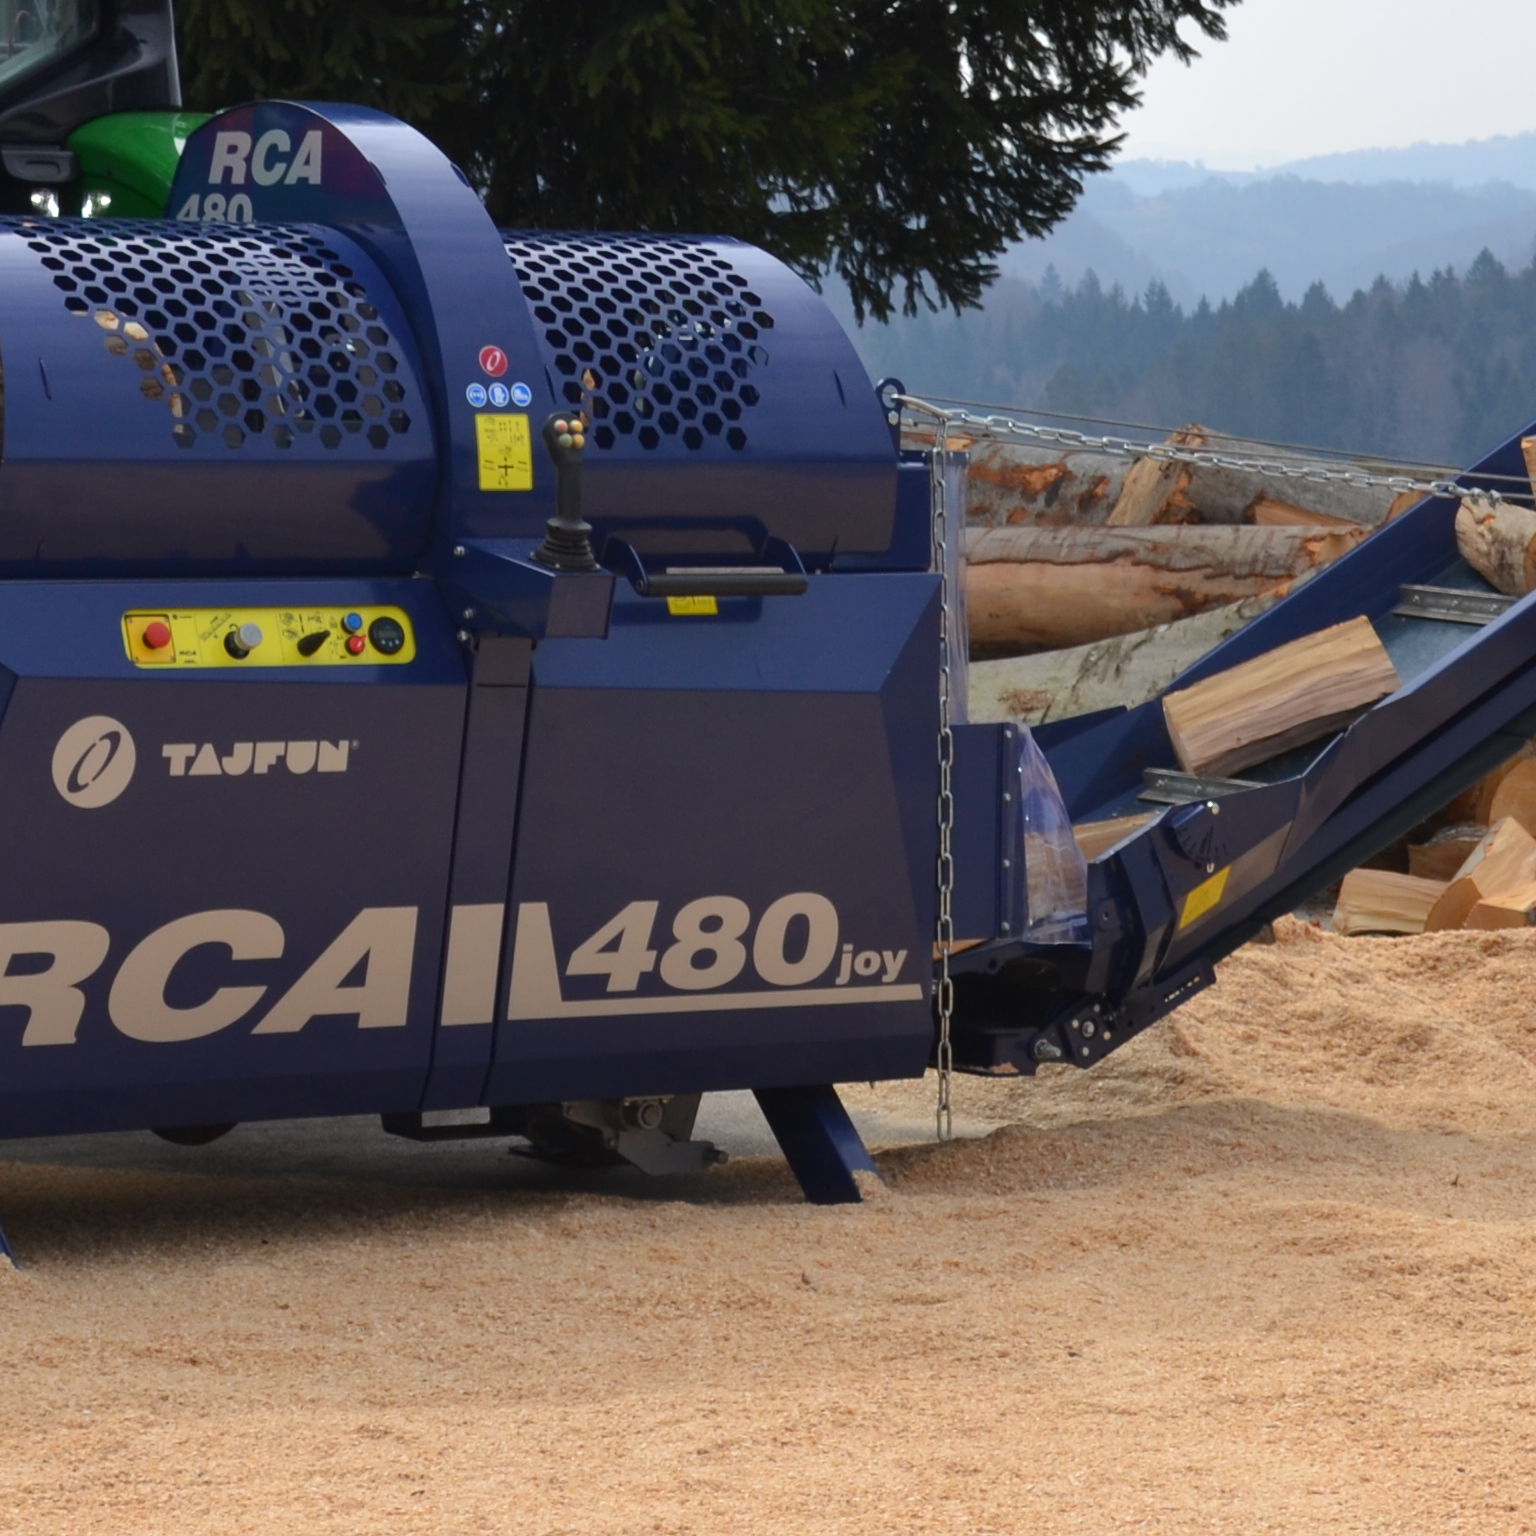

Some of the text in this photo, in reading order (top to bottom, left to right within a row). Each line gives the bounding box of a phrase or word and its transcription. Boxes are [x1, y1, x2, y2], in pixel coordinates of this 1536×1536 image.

[208, 129, 323, 186] RCA
[176, 192, 254, 223] 480
[162, 740, 349, 776] TAJFUN
[565, 892, 839, 993] 480
[835, 943, 908, 985] joy
